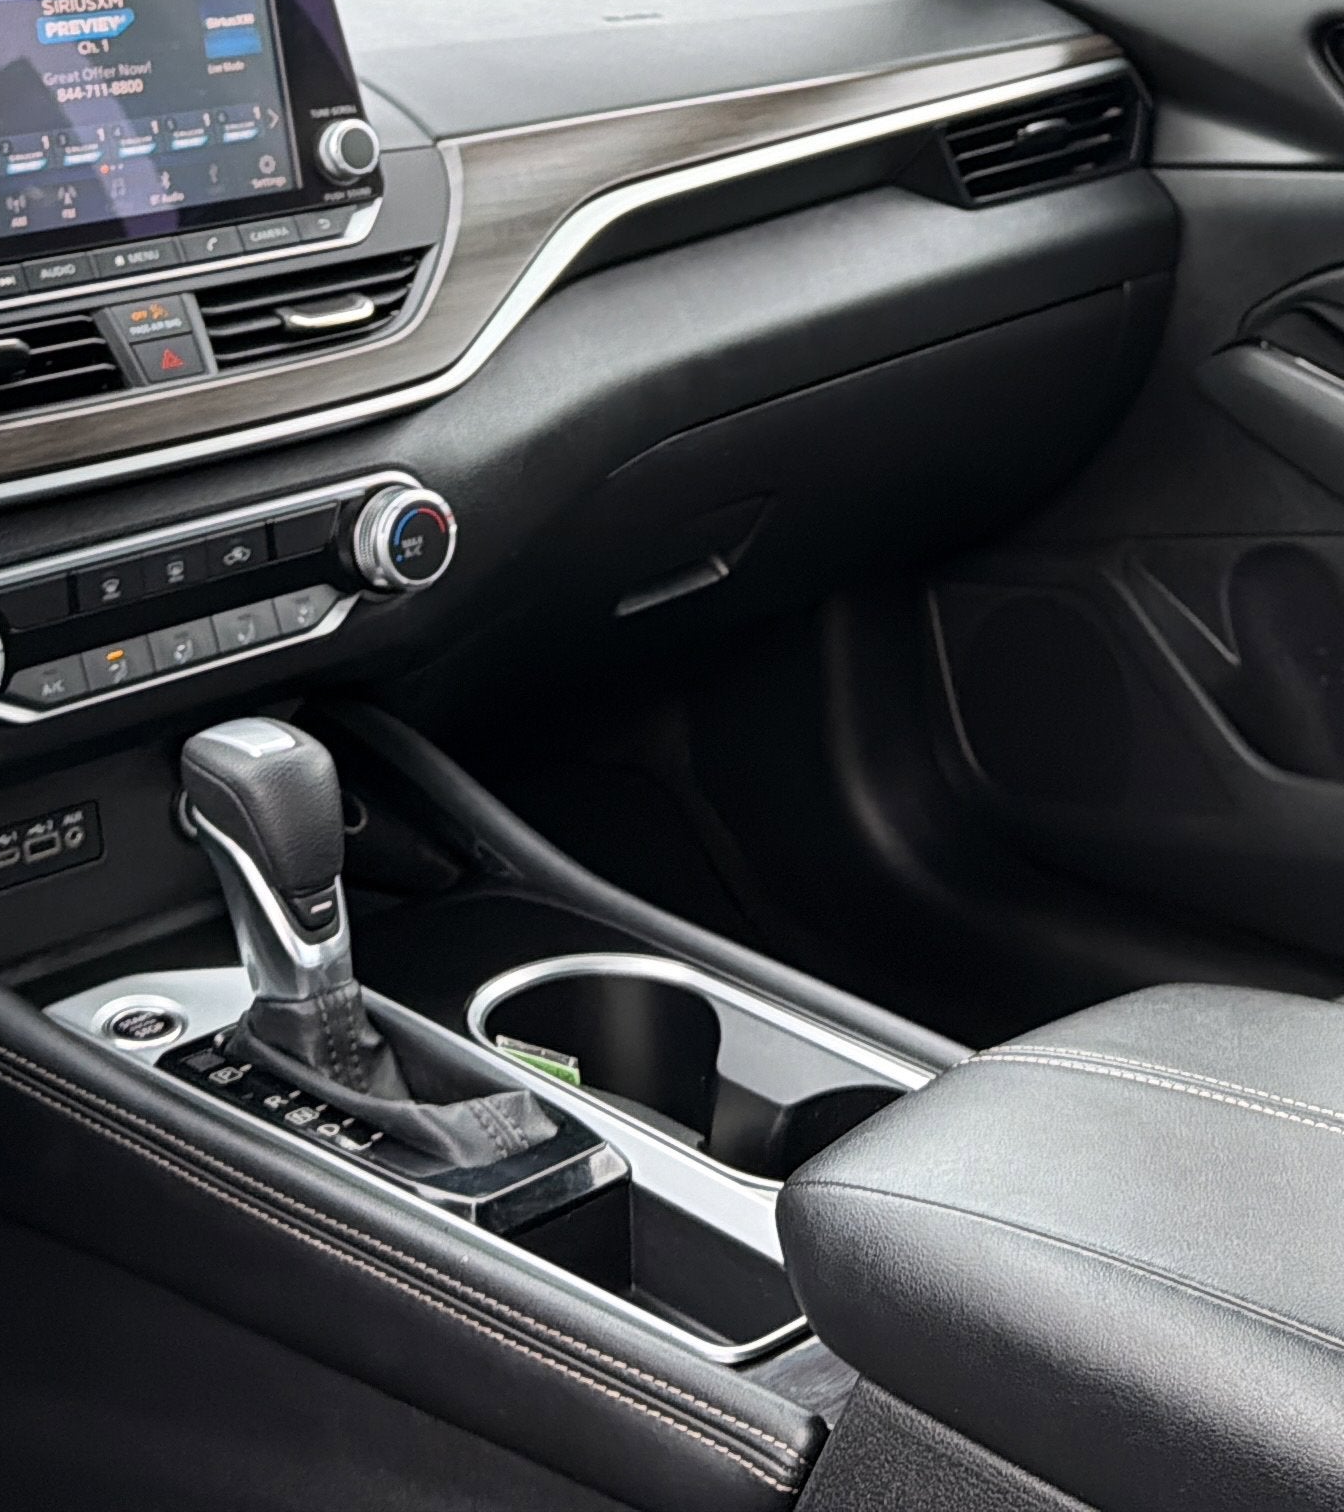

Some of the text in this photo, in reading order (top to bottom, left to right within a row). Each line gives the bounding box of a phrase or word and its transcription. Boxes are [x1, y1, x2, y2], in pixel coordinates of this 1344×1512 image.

[77, 39, 110, 55] Ch. 1
[42, 60, 152, 87] Great Offer Now!
[127, 249, 160, 265] MENU
[39, 262, 77, 280] AUDIO
[41, 679, 65, 696] A/C
[317, 1123, 340, 1137] D
